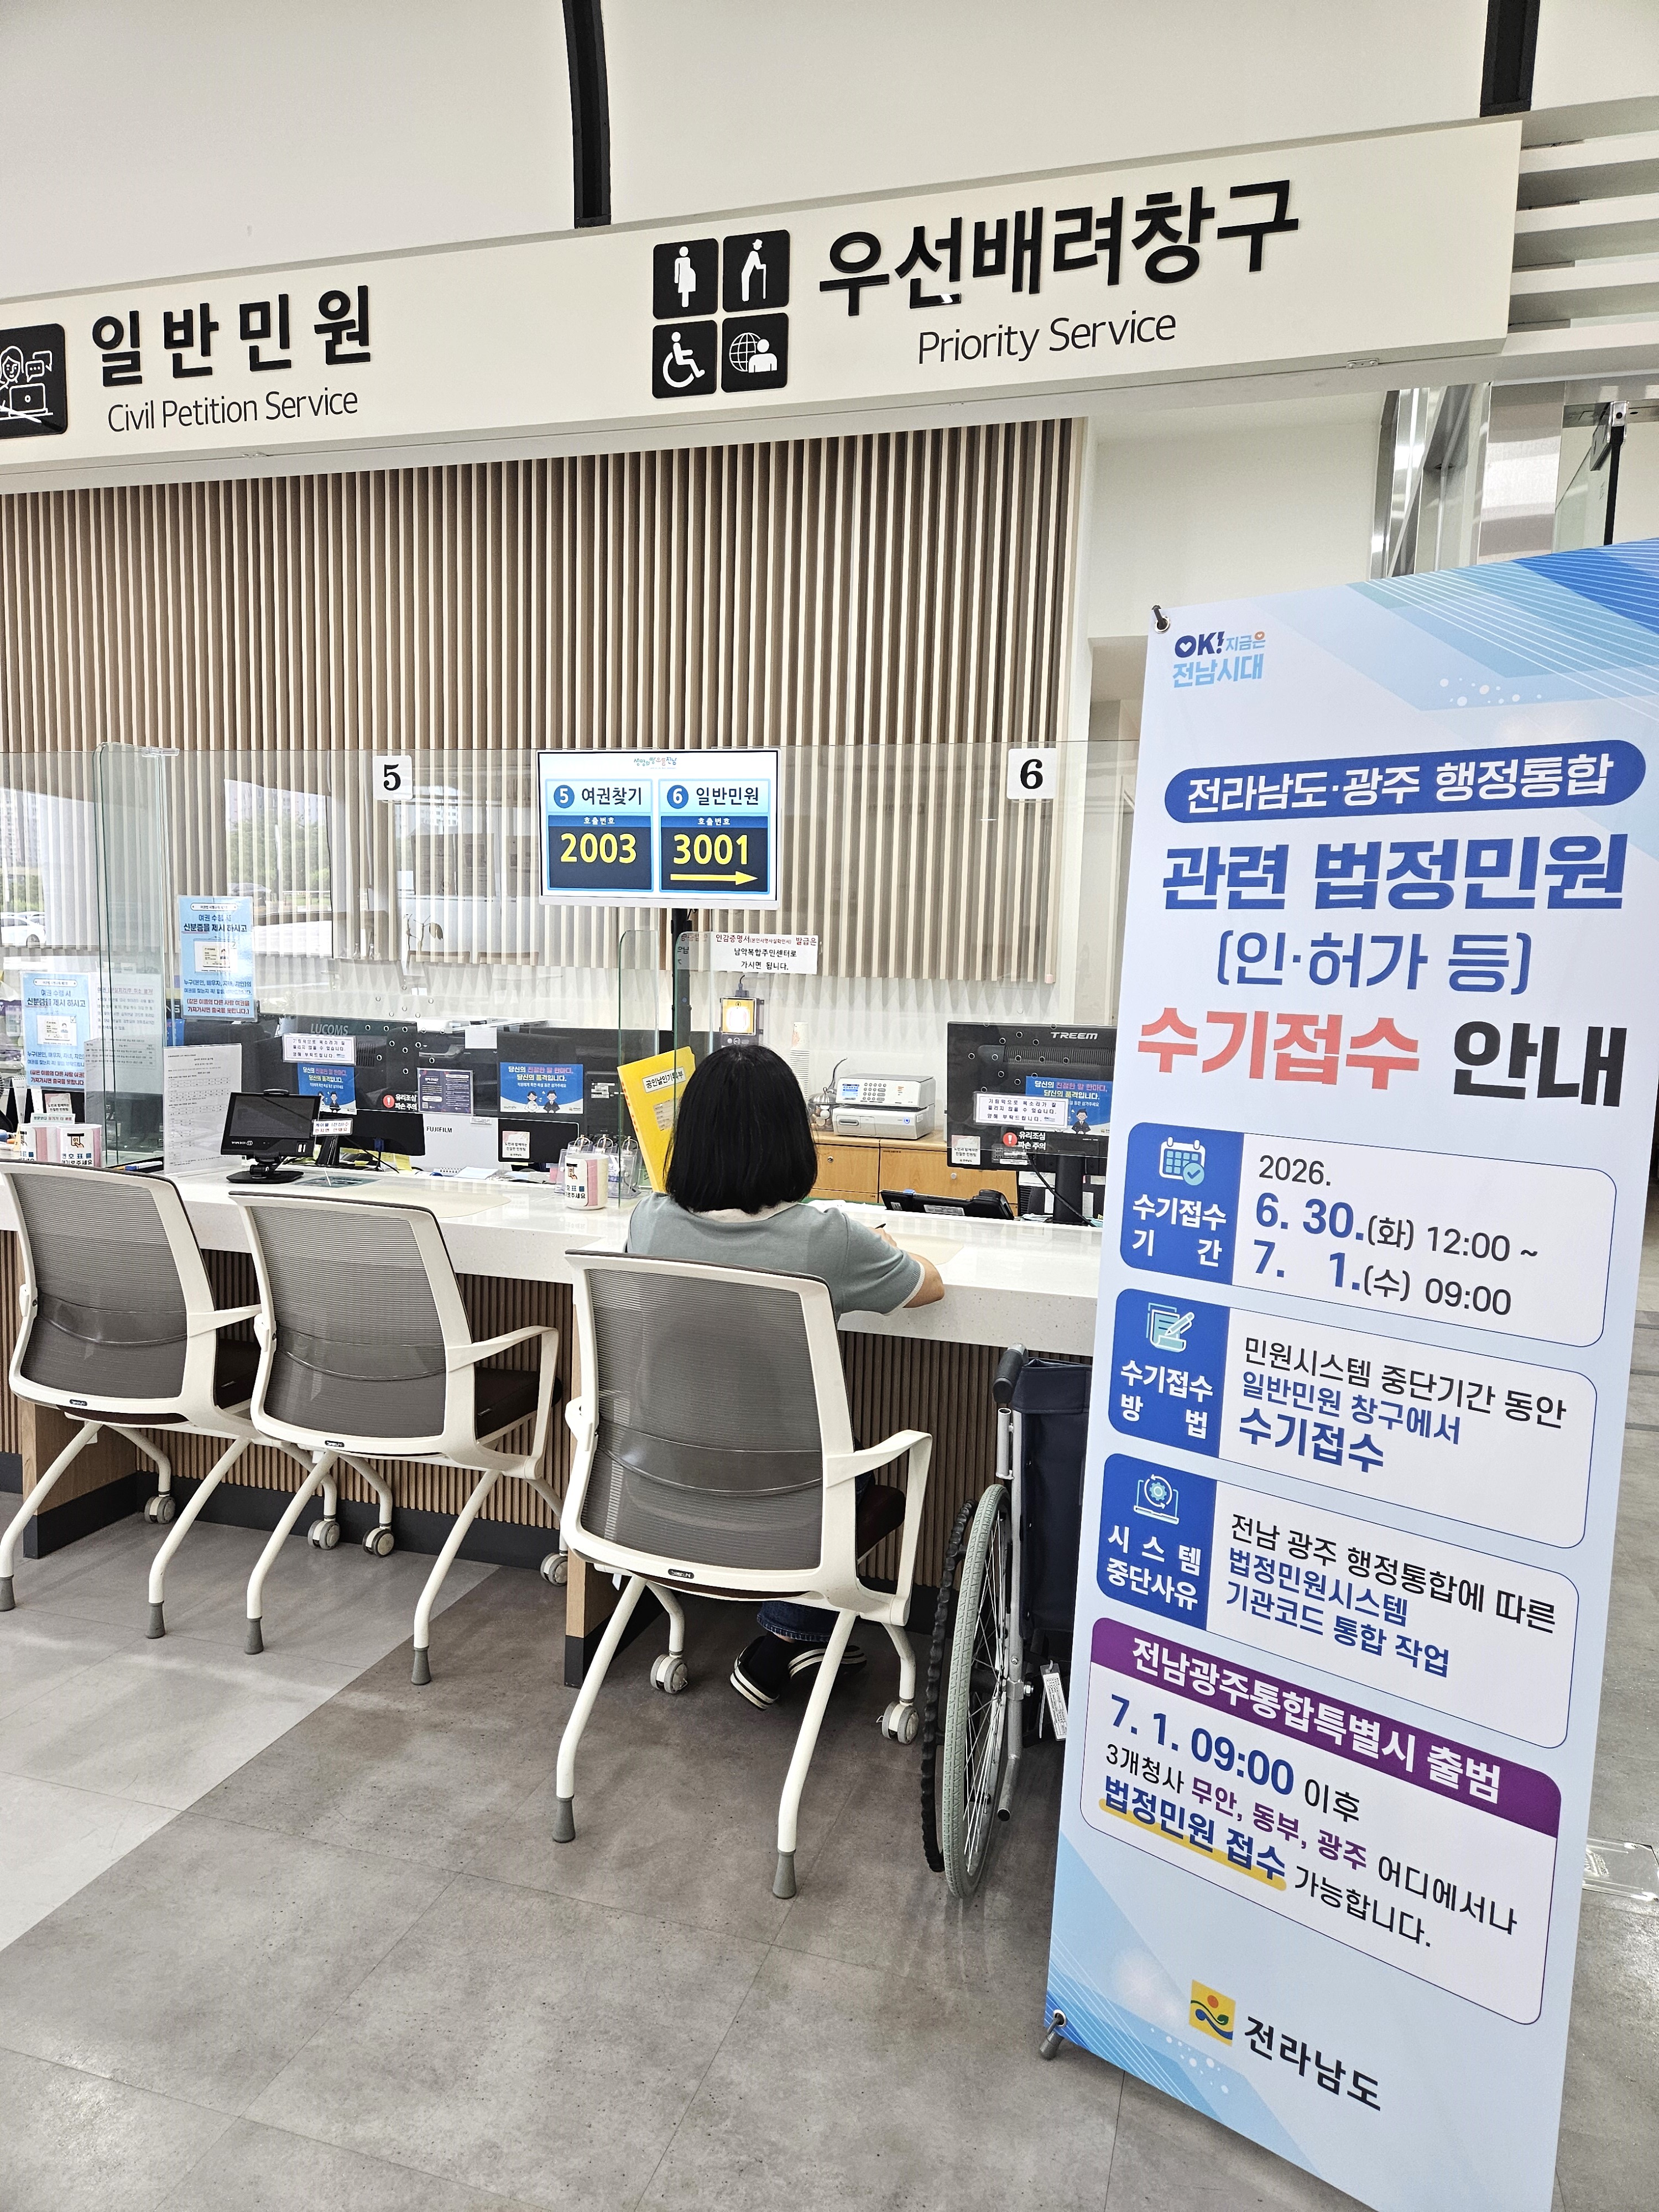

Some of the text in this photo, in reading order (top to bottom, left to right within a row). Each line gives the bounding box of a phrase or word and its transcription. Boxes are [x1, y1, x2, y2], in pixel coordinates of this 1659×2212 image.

[820, 180, 1299, 316] 우선배려창구
[92, 285, 371, 387] 일반민원
[918, 310, 1176, 364] Priority Service
[108, 388, 358, 432] Civil Petition Service
[1174, 630, 1266, 659] OK! 지금은
[1172, 654, 1264, 688] 전남시대
[384, 764, 401, 791] 5
[1020, 759, 1043, 789] 6
[1187, 753, 1614, 814] 전라남도·광주 행정통합
[560, 787, 642, 805] 5 여권찾기
[672, 788, 759, 805] 6 일반민원
[584, 817, 615, 826] 호출번호
[698, 817, 731, 826] 호출번호
[560, 833, 637, 864] 2003
[673, 834, 748, 865] 3001
[1162, 834, 1628, 911] 관련 법정민원
[734, 948, 797, 957] 남악복합주민센터로
[796, 937, 817, 946] 발급은
[741, 961, 789, 971] 가시면 됩니다.
[1448, 932, 1531, 995] 등)
[27, 998, 51, 1006] 신분증을
[311, 1024, 348, 1035] LUCOMS
[1138, 1007, 1628, 1107] 수기접수 안내
[395, 1094, 418, 1102] 유리조심
[646, 1071, 684, 1089] 공인날인기록부
[1065, 1091, 1100, 1099] 품격입니다.
[1018, 1141, 1046, 1150] 파손 주의
[1019, 1131, 1046, 1140] 유리조심
[1259, 1154, 1332, 1186] 2026.
[1132, 1193, 1227, 1232] 수기접수
[1256, 1192, 1289, 1230] 6.
[1427, 1226, 1511, 1262] 12:00
[1254, 1242, 1285, 1279] 7.
[1425, 1277, 1512, 1316] 09:00
[1120, 1359, 1214, 1399] 수기접수
[1245, 1336, 1567, 1430] 민원시스템 중단기간 동안
[1241, 1370, 1460, 1446] 일반민원 창구에서
[1239, 1407, 1385, 1474] 수기접수
[1106, 1559, 1198, 1611] 중단사유
[1228, 1547, 1408, 1627] 법정민원시스템
[1230, 1513, 1557, 1634] 전남 광주 행정통합에 따른
[1227, 1580, 1449, 1678] 기관코드 통합 작업
[1132, 1636, 1416, 1773] 전남광주통합특별시
[1427, 1743, 1502, 1804] 출범
[1110, 1694, 1138, 1734] 7.
[1156, 1713, 1179, 1751] 1.
[1192, 1728, 1294, 1795] 09:00
[1304, 1778, 1361, 1824] 이후
[1105, 1744, 1518, 1935] 3개청사 무안, 동부, 광주 어디에서나
[1104, 1775, 1432, 1948] 법정민원 접수 가능합니다.
[1245, 2015, 1381, 2111] 전라남도
